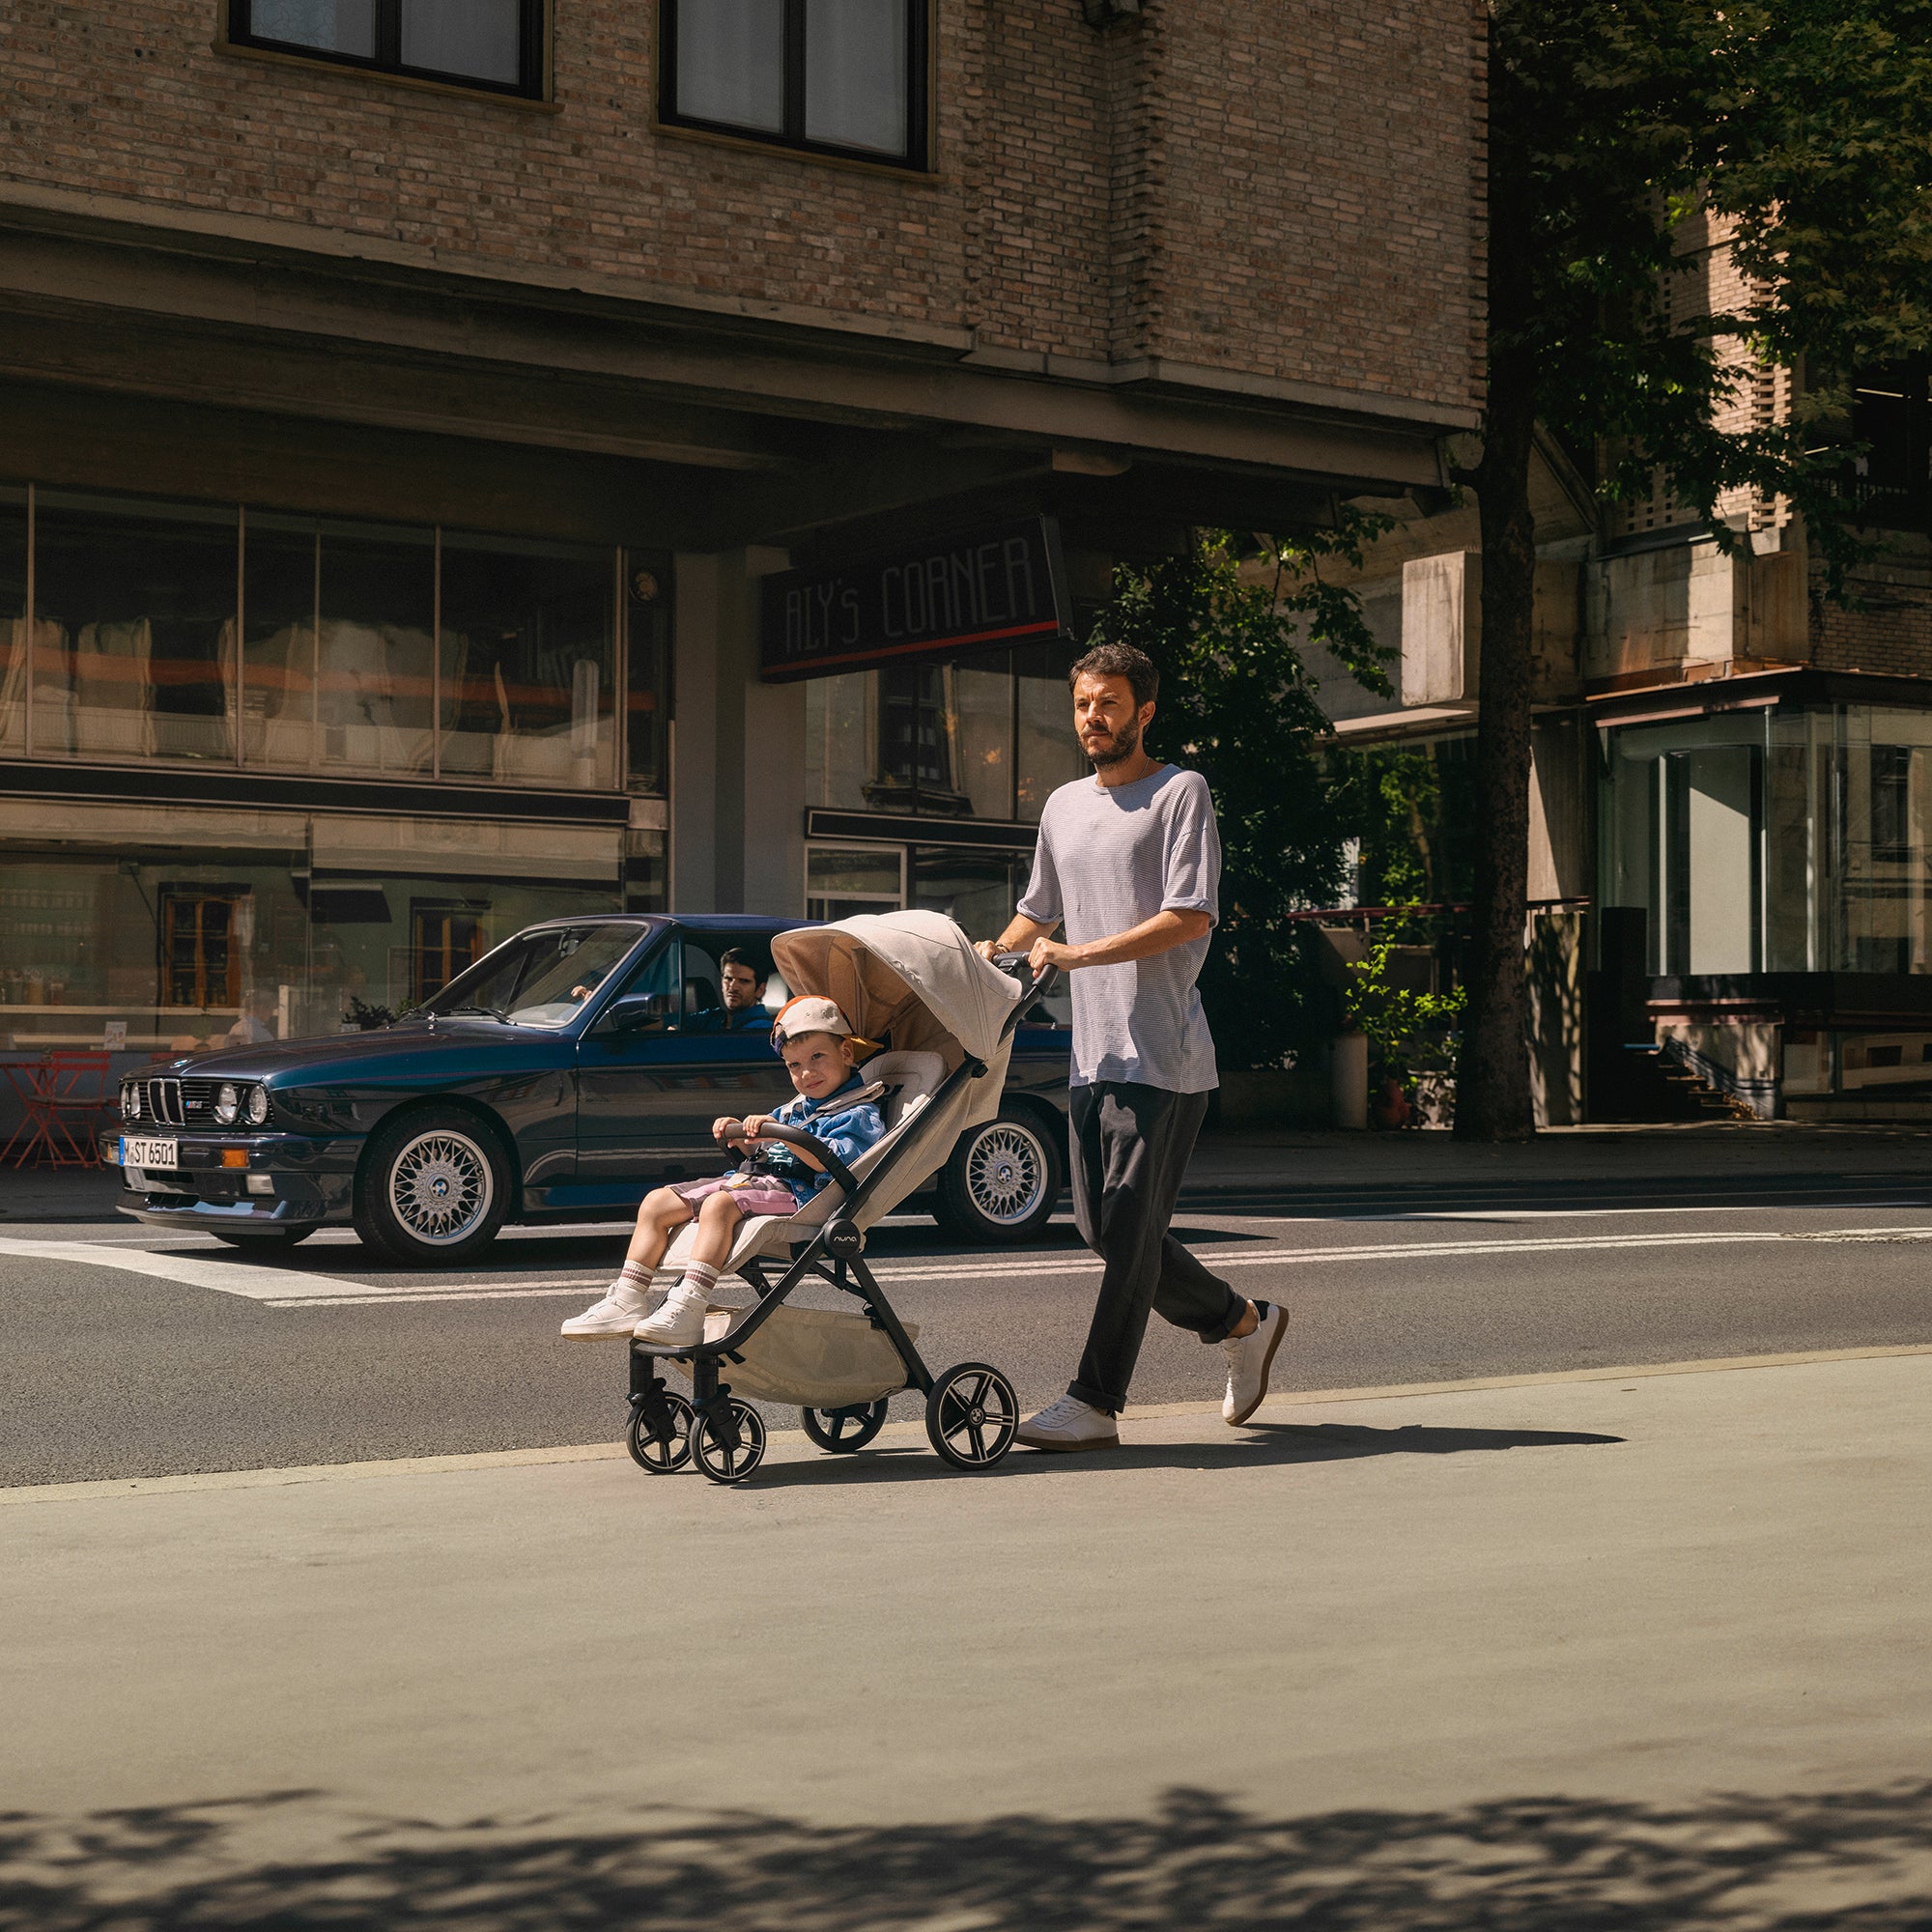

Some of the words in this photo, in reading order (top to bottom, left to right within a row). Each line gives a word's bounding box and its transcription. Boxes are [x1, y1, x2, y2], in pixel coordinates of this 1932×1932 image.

[881, 536, 1037, 638] CORNER
[134, 1141, 147, 1164] ST
[149, 1142, 176, 1166] 6501
